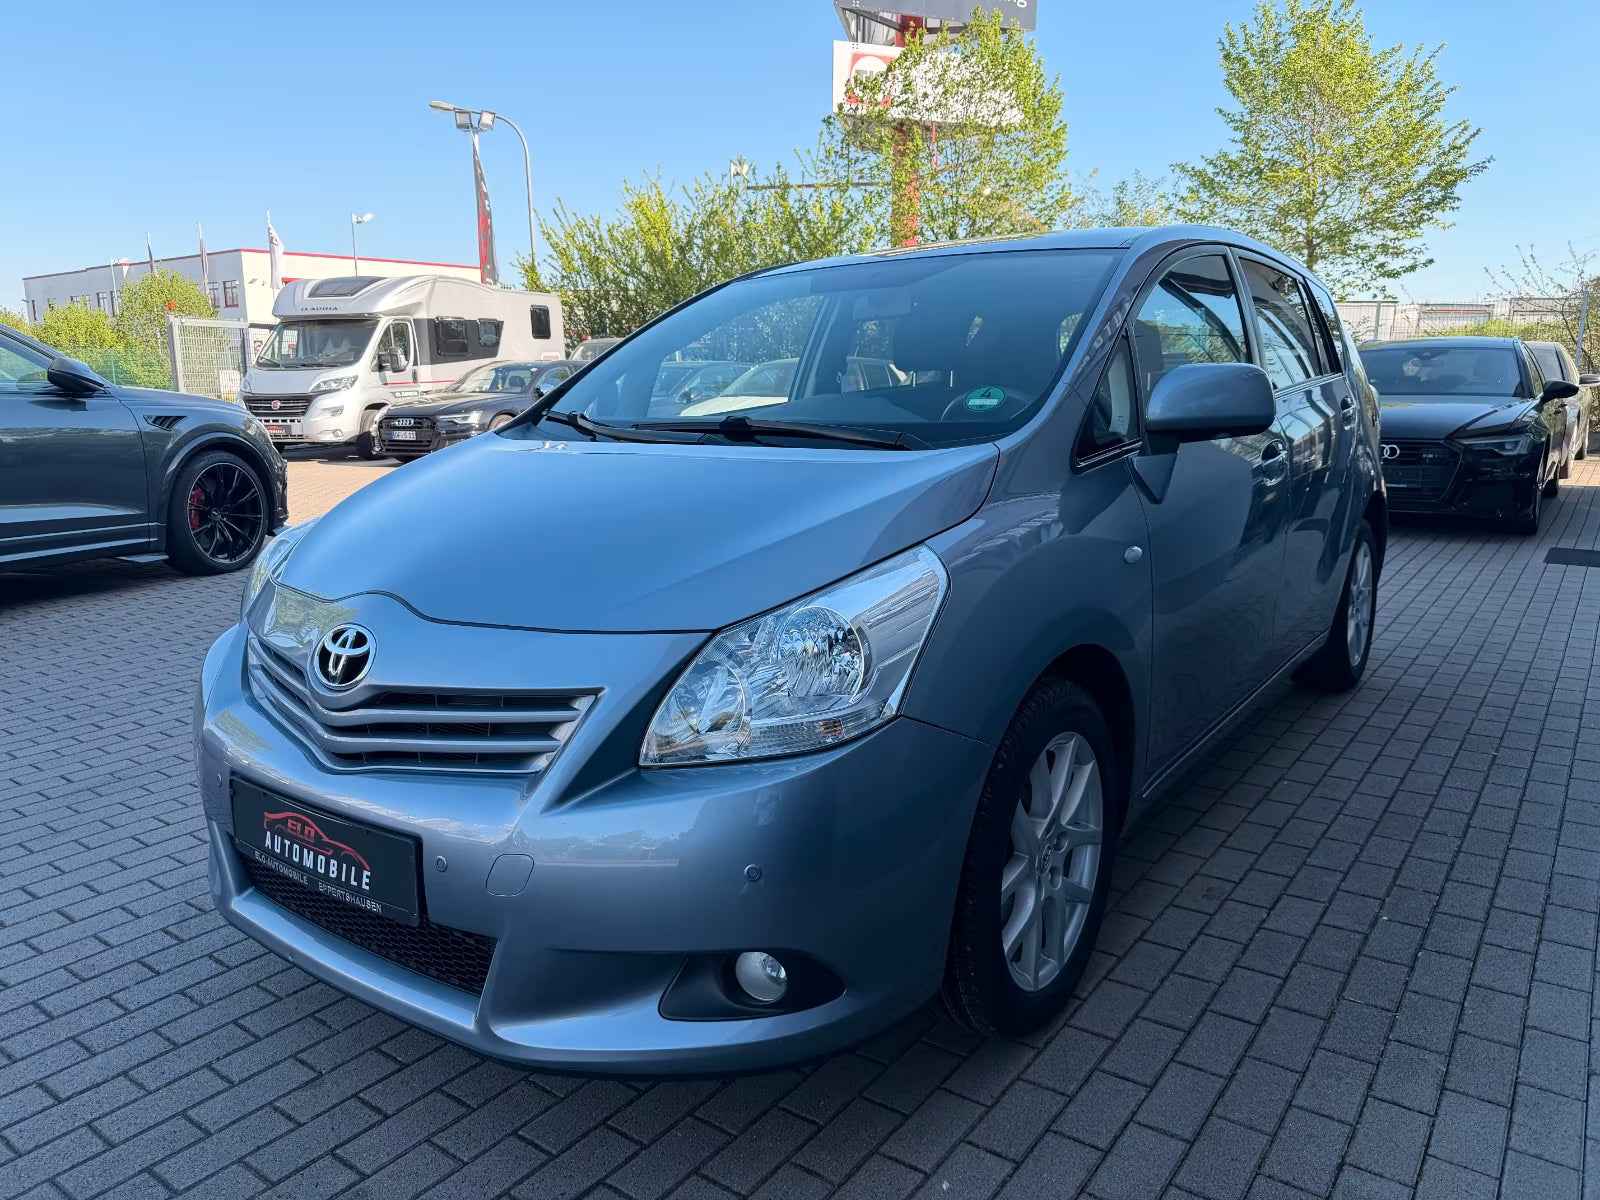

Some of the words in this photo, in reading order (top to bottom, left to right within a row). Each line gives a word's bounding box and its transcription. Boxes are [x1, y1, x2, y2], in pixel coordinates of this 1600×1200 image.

[980, 387, 993, 398] 4
[287, 818, 316, 843] ELO
[265, 830, 371, 891] AUTOMOBILE
[318, 881, 383, 913] EPPERTSHAUSEN
